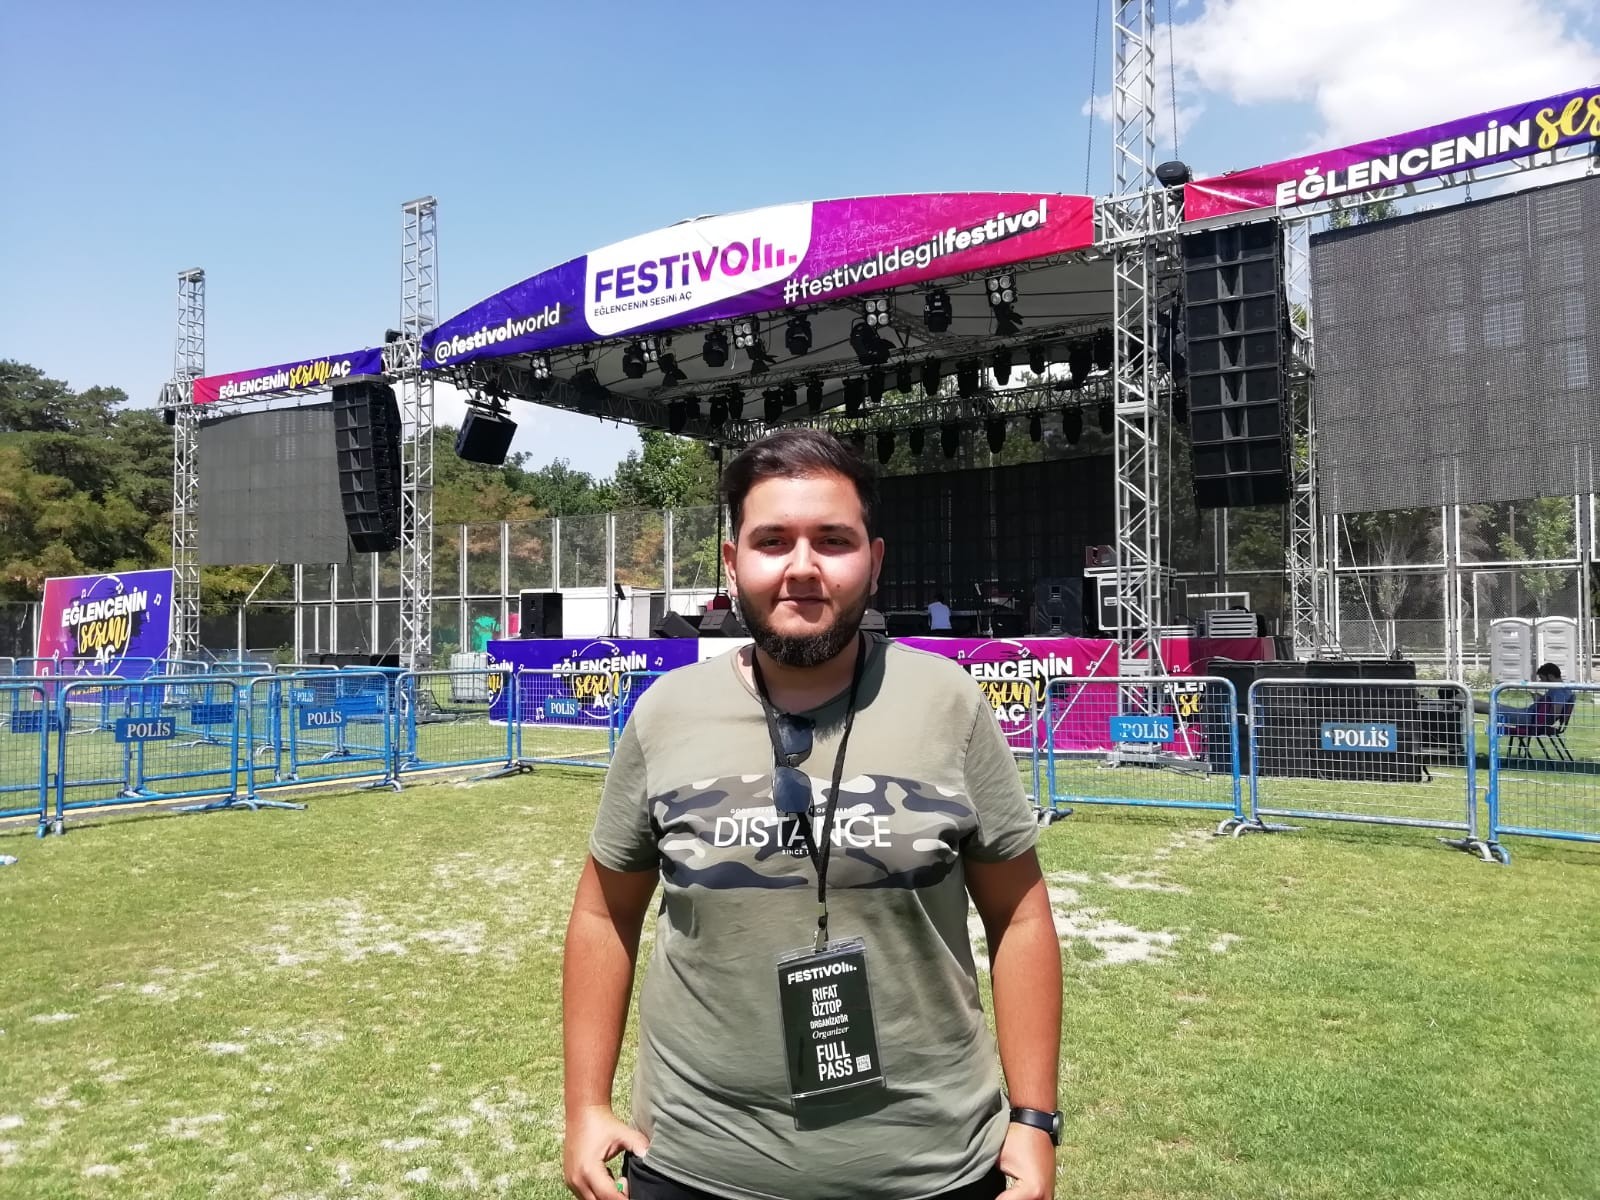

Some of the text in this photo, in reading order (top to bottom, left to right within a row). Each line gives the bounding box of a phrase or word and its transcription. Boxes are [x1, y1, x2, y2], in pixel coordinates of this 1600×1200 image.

[1276, 118, 1530, 207] EĞLENCENİN
[783, 199, 1047, 304] #festivaldegilfestivol
[679, 291, 692, 301] AÇ
[434, 302, 560, 364] @festivolworld
[219, 356, 351, 399] EĞLENCENİN sesini AÇ
[62, 587, 147, 627] EĞLENCENİN
[552, 651, 647, 678] EĞLENCENİN
[970, 652, 1073, 678] ENCENİN
[307, 708, 342, 725] POLİS
[550, 701, 575, 715] POLİS
[995, 704, 1025, 725] AÇ
[127, 720, 171, 738] POLİS
[1121, 721, 1169, 738] POLİS
[1333, 727, 1389, 748] POLİS
[714, 815, 892, 847] DISTANCE
[812, 999, 842, 1017] ÖZTOP
[812, 1026, 849, 1040] Organizer
[816, 1040, 850, 1063] FULL
[818, 1058, 853, 1081] PASS
